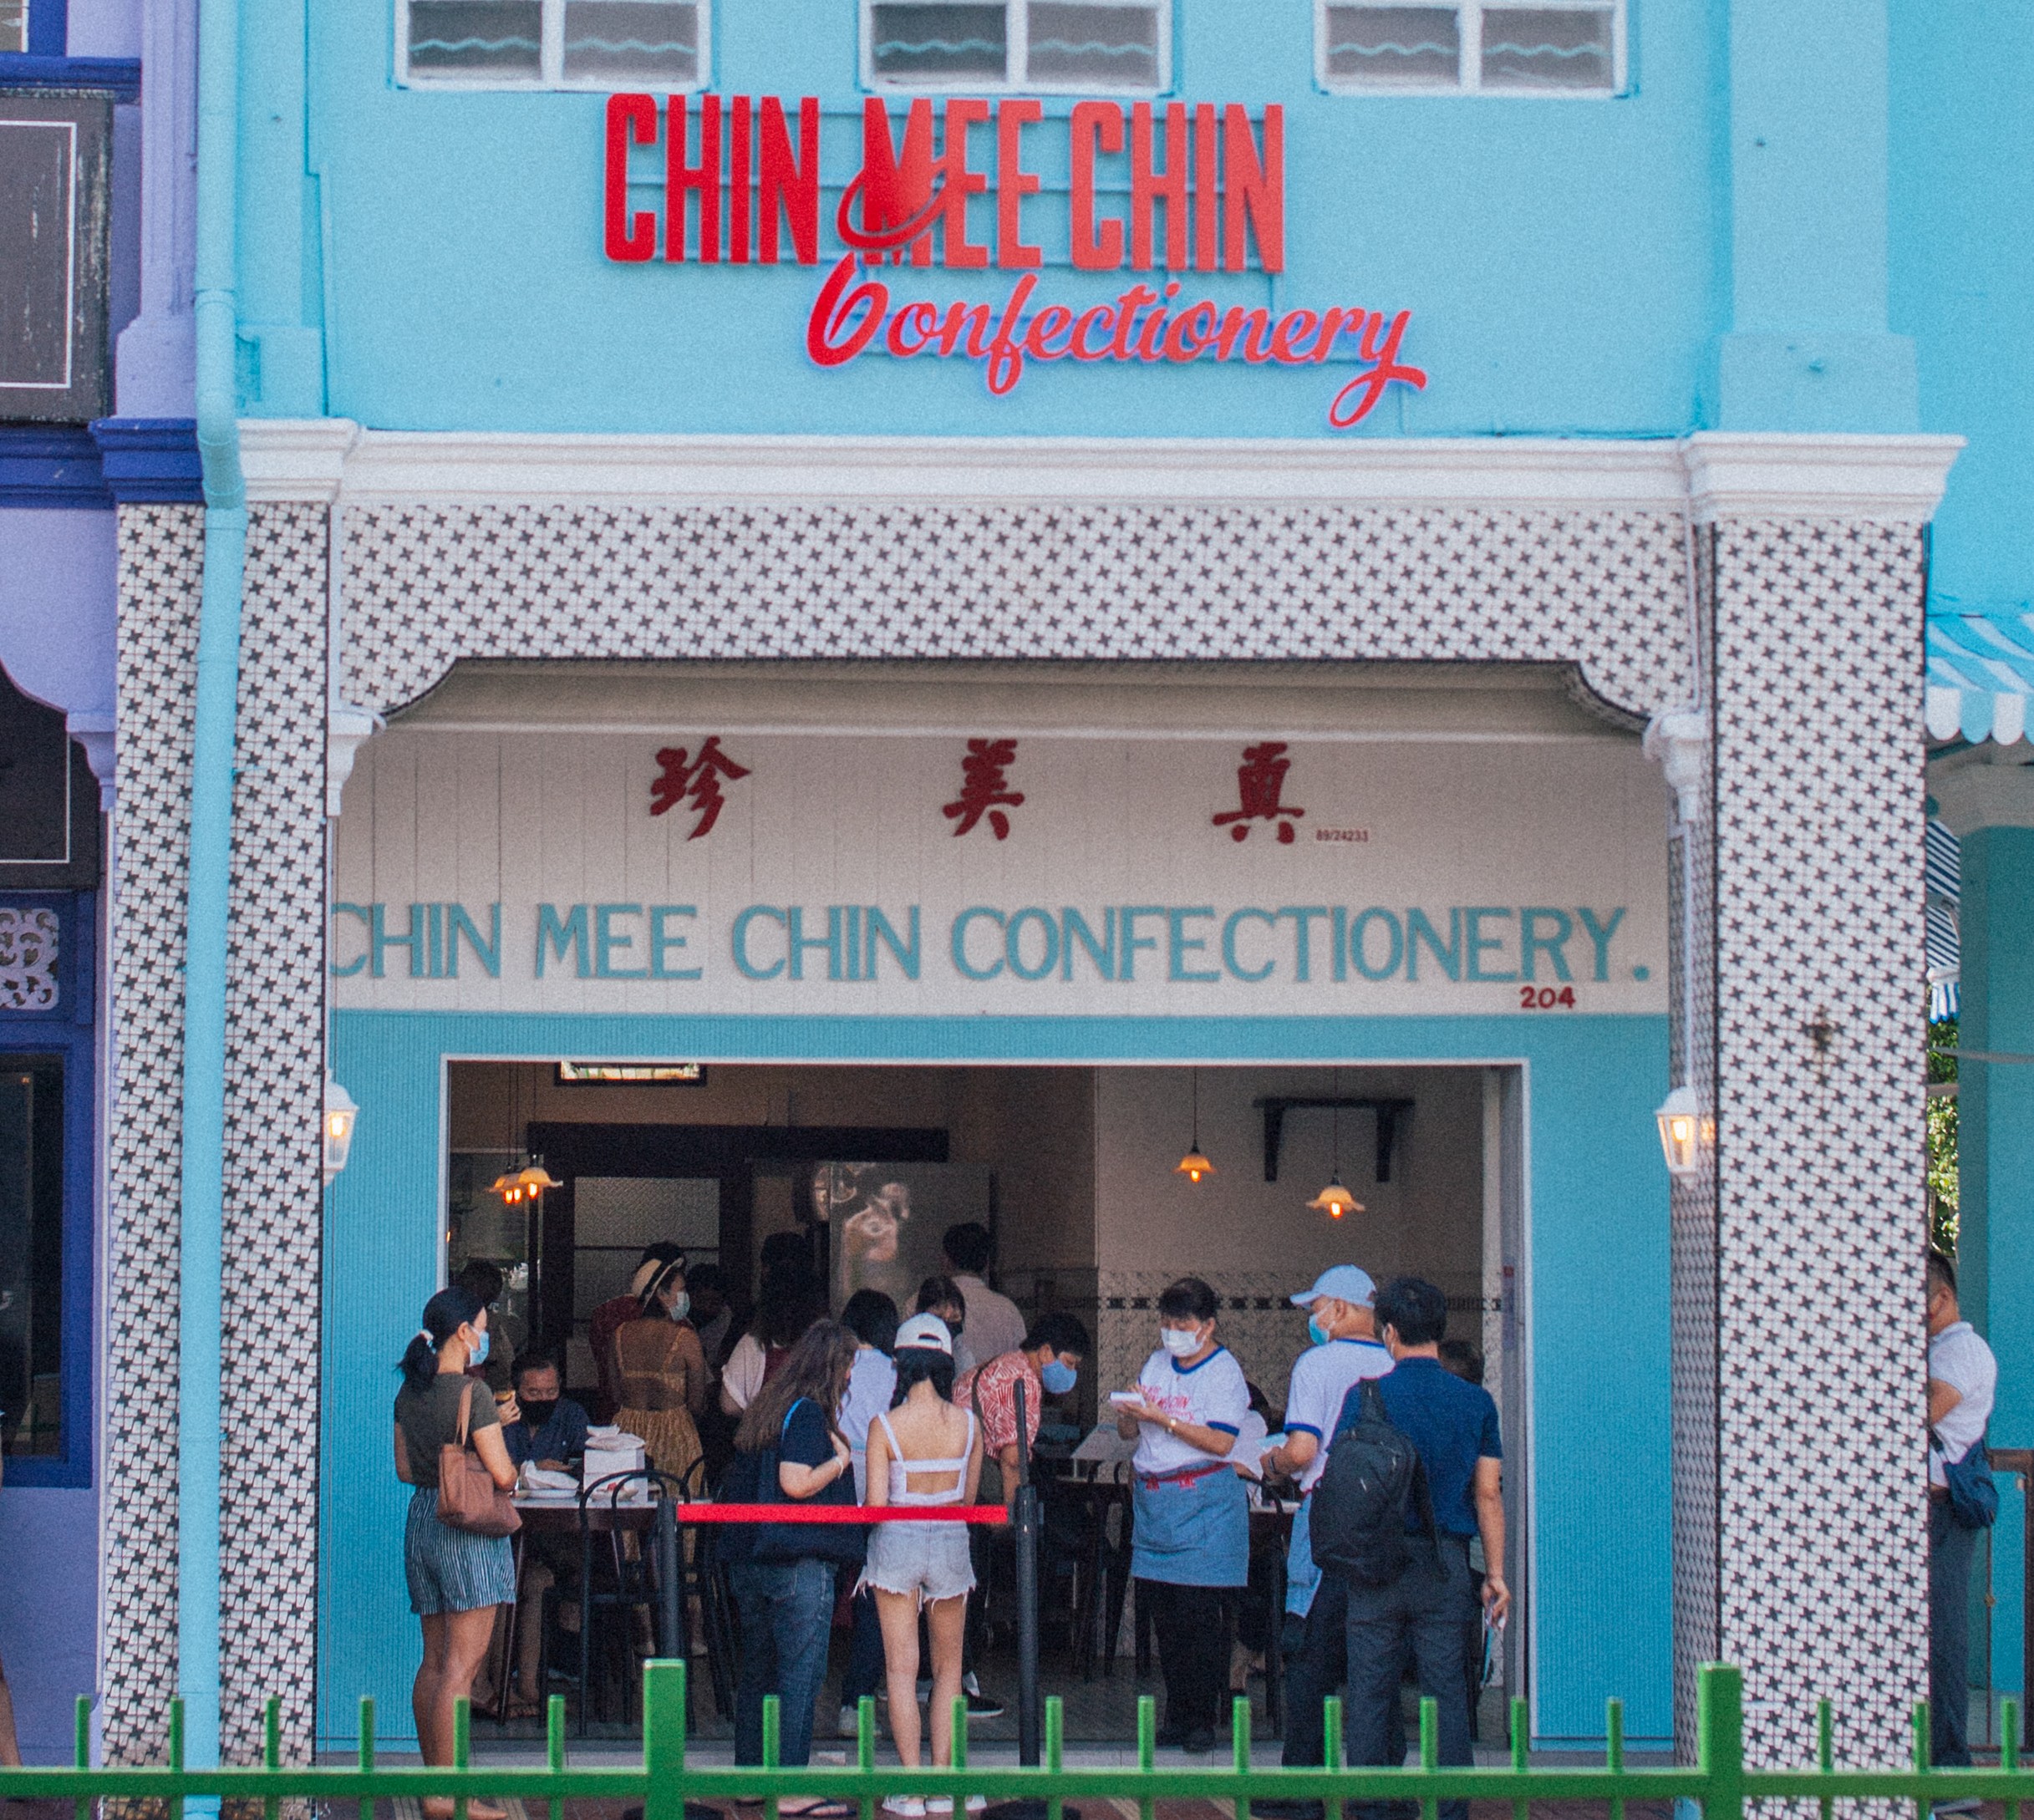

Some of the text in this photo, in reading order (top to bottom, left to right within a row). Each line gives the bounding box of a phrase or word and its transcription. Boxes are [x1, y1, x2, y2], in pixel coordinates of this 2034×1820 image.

[604, 93, 1284, 272] CHIN MEE CHIN
[806, 252, 1426, 428] Confectionery
[331, 902, 1650, 982] CHIN MEE CHIN CONFECTIONERY.
[1519, 984, 1577, 1009] 204
